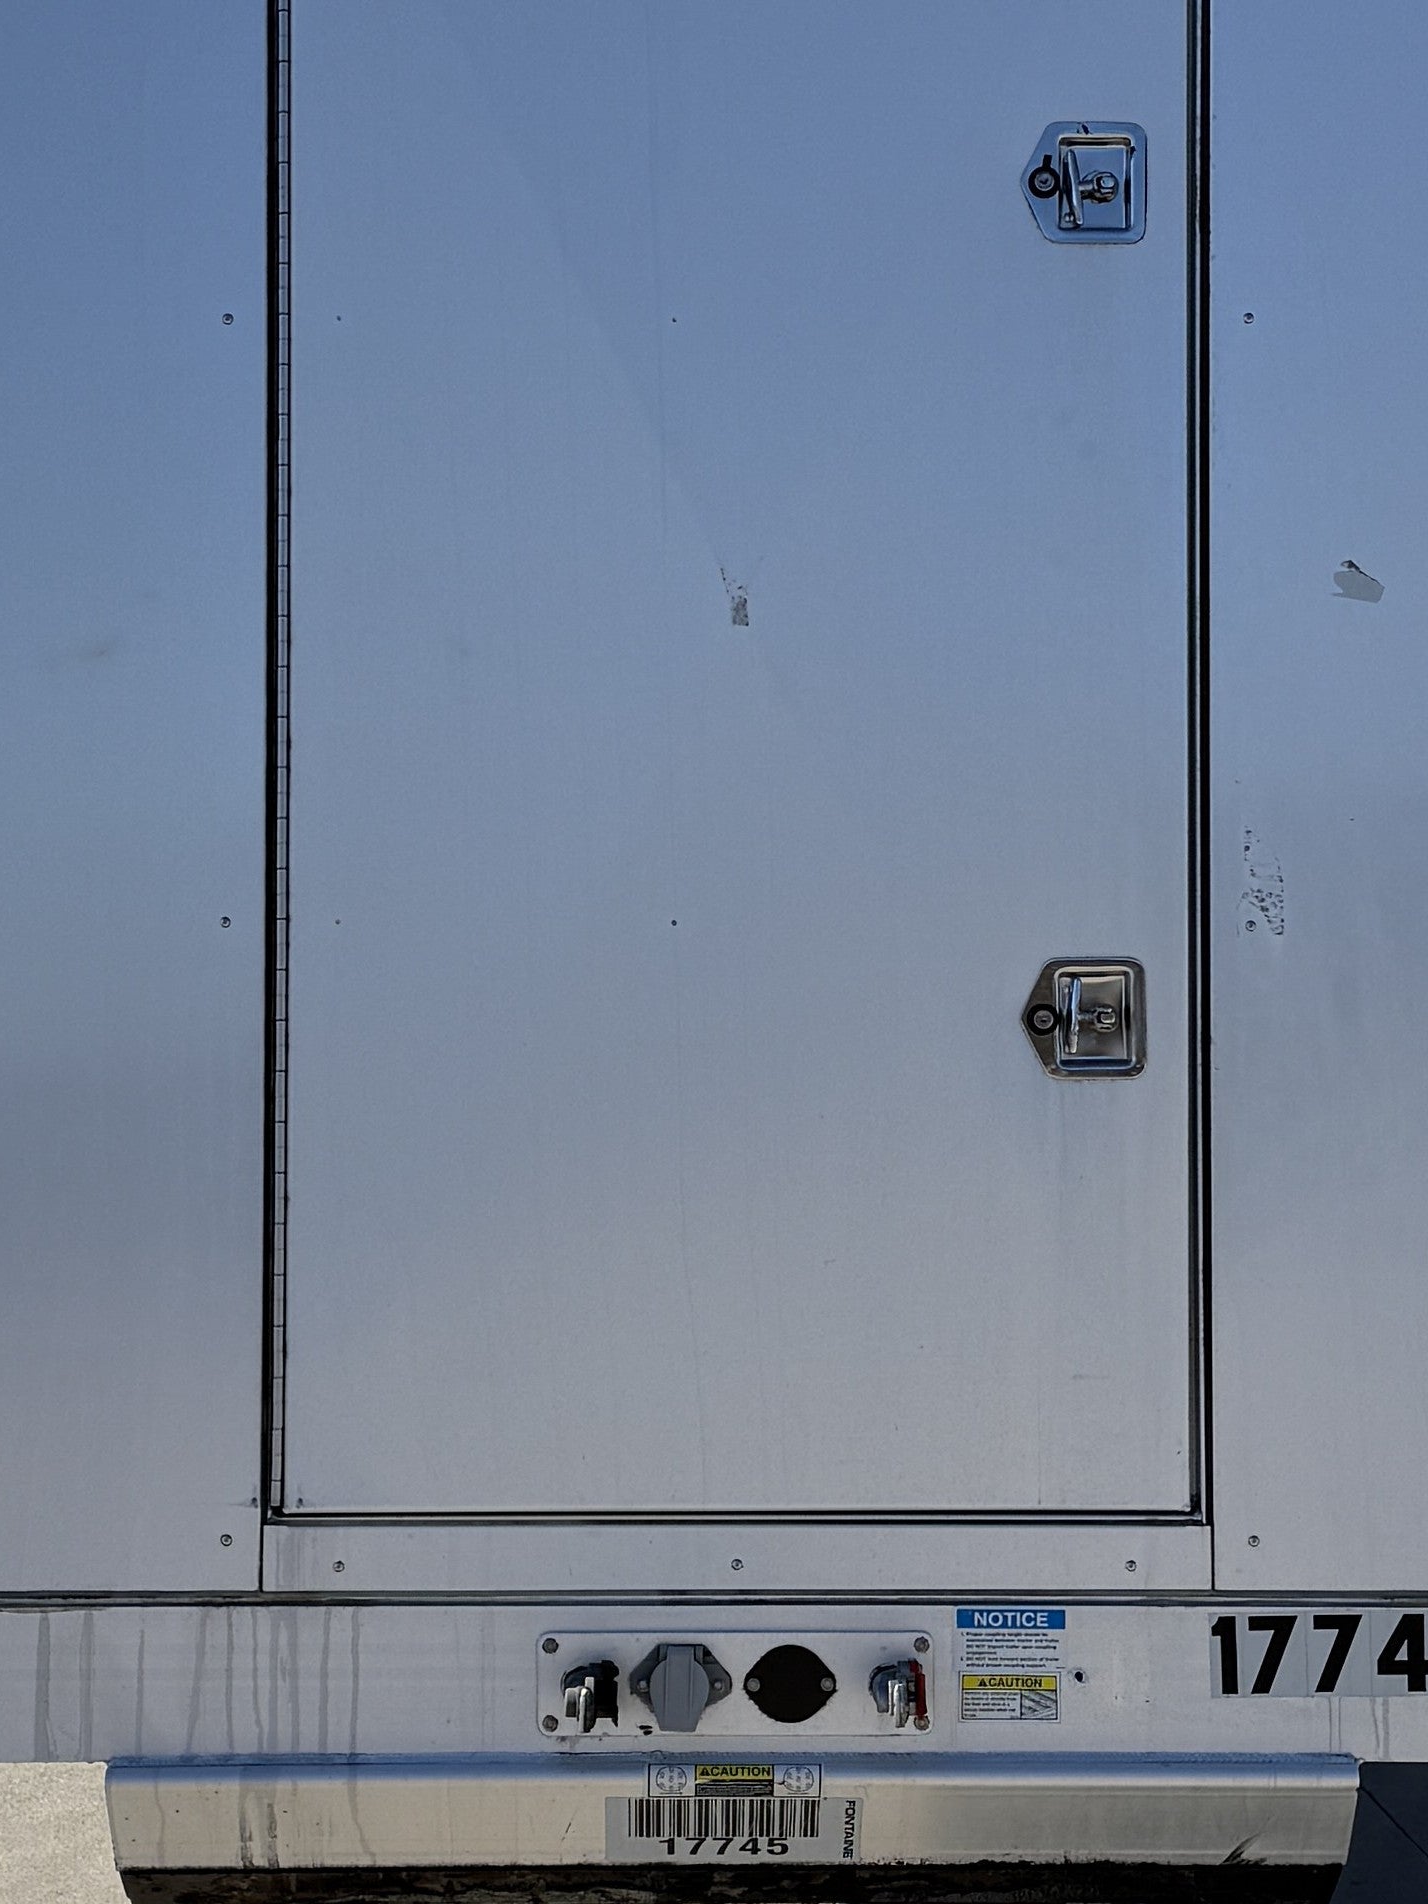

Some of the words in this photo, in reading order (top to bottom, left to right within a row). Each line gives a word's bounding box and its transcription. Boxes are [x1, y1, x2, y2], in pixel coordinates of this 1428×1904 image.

[974, 1612, 1049, 1627] NOTICE
[989, 1678, 1043, 1688] CAUTION
[710, 1767, 771, 1777] CAUTION
[843, 1800, 856, 1860] FONTAINE
[659, 1838, 789, 1855] 17745
